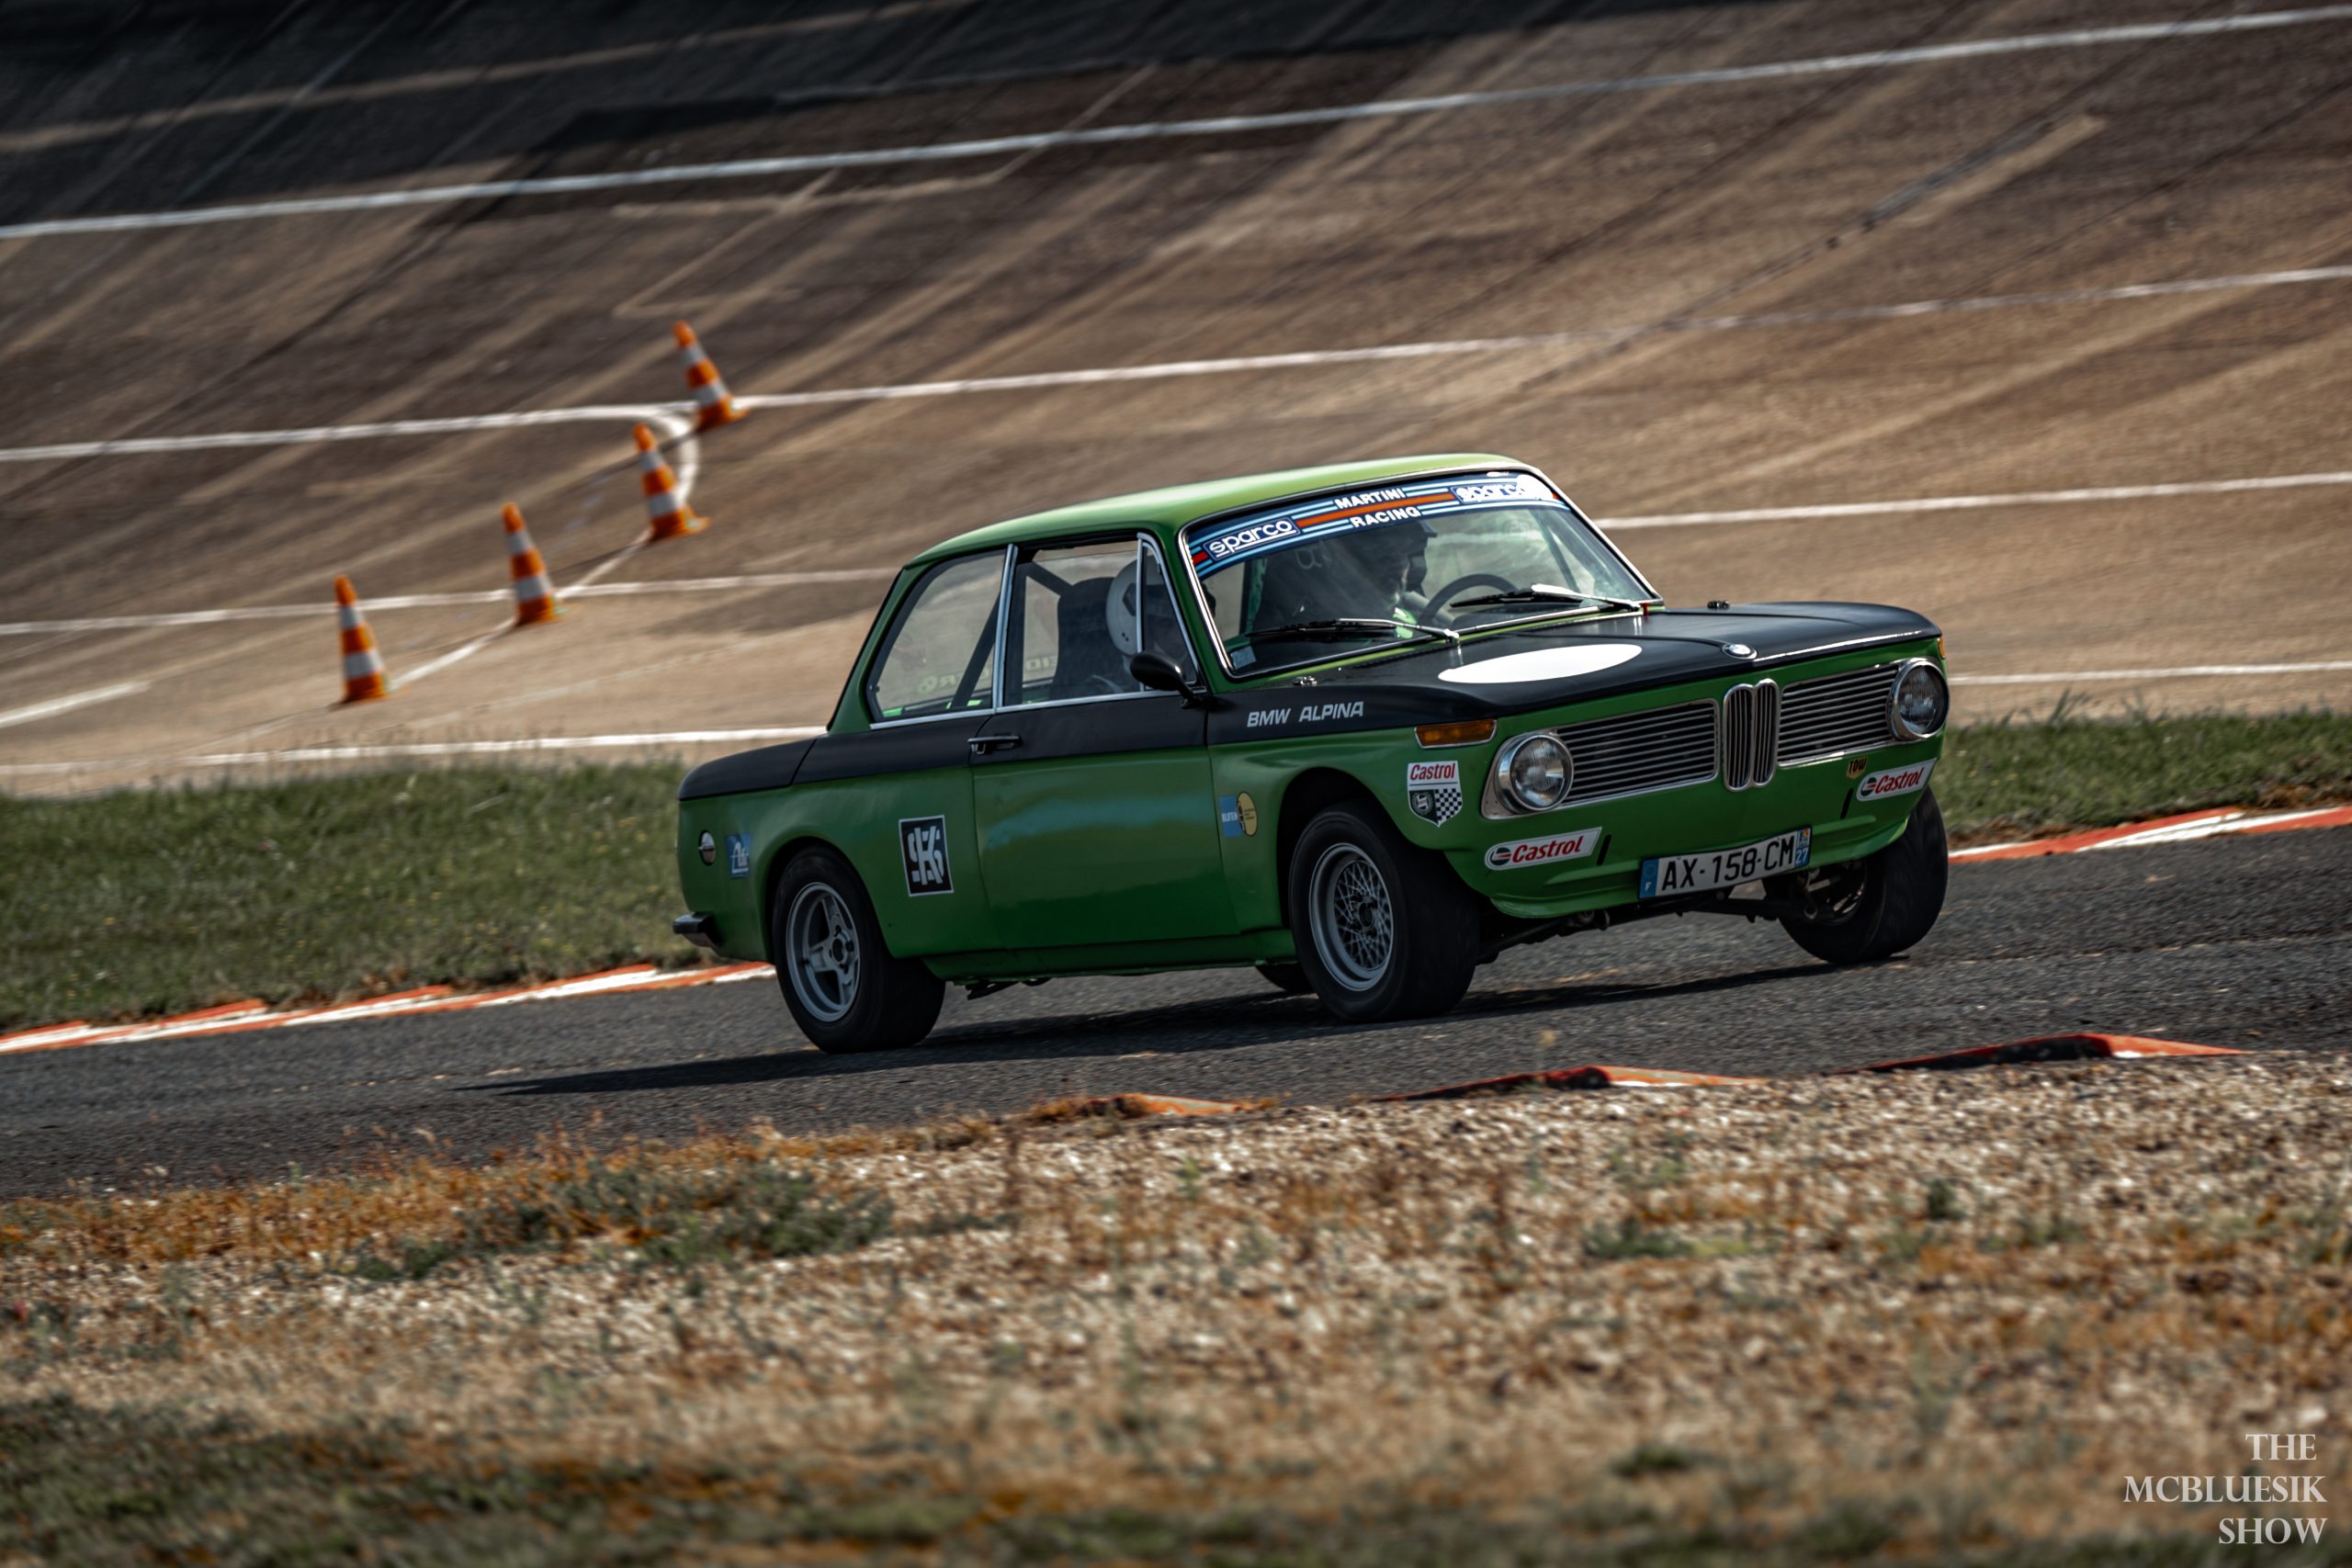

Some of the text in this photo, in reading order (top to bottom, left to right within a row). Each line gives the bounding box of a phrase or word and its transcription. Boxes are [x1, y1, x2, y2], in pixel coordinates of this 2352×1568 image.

[1335, 488, 1406, 511] MARTINI
[1350, 505, 1421, 528] RACING
[1209, 519, 1293, 553] sparco
[1247, 701, 1364, 728] BMW ALPINA
[1409, 761, 1456, 781] Castrol
[1849, 757, 1867, 773] TOW
[1875, 766, 1925, 795] Castrol
[1511, 835, 1584, 863] Castrol
[1795, 847, 1809, 864] 27
[1661, 835, 1795, 891] AX-158-CM
